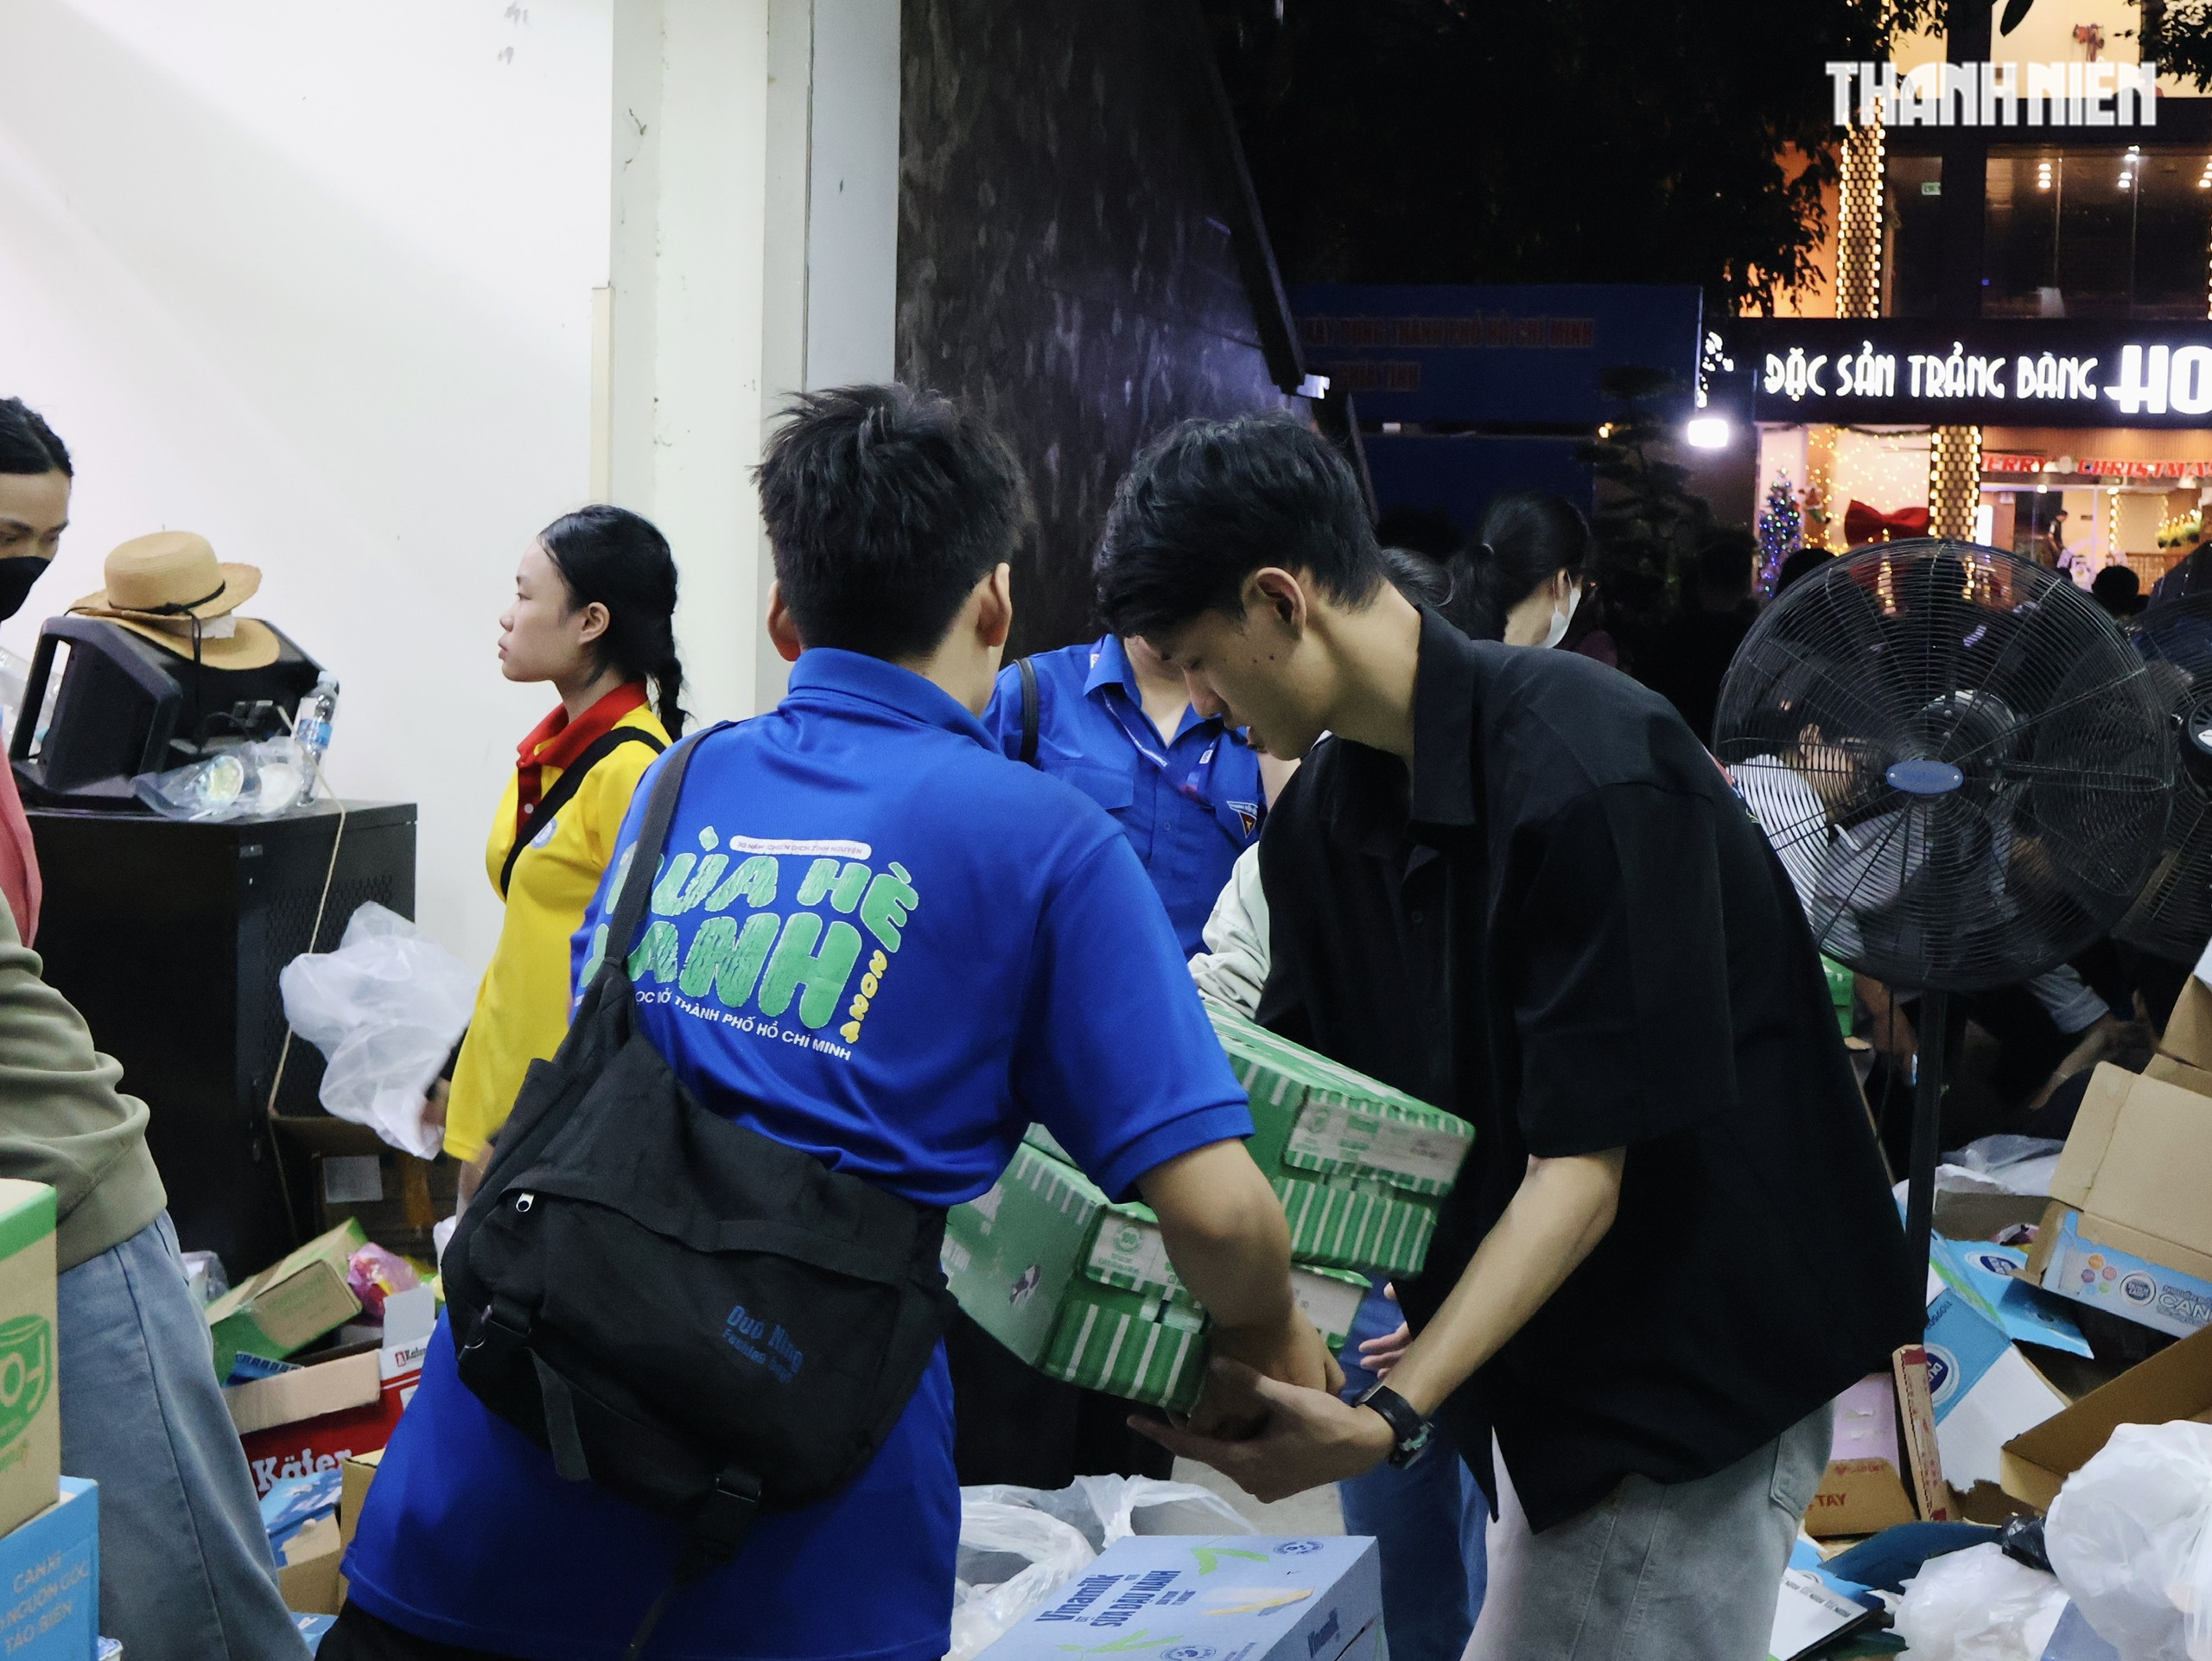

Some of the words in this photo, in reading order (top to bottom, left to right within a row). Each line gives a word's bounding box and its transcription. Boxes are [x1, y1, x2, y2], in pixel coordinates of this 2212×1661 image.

[1764, 347, 1828, 402] ĐẶC
[1835, 340, 1896, 398] SẢN
[1907, 340, 2006, 399] TRẢNG
[2077, 457, 2212, 477] CHRISTMA
[797, 862, 919, 953] HÈ
[674, 995, 721, 1022] THÀNH
[721, 1014, 757, 1033] PHỐ
[756, 1021, 779, 1039] HỒ
[781, 1029, 811, 1048] CHÍ
[812, 1039, 852, 1061] MINH
[840, 949, 887, 1044] 2024
[1033, 1574, 1126, 1623] Vinamilk
